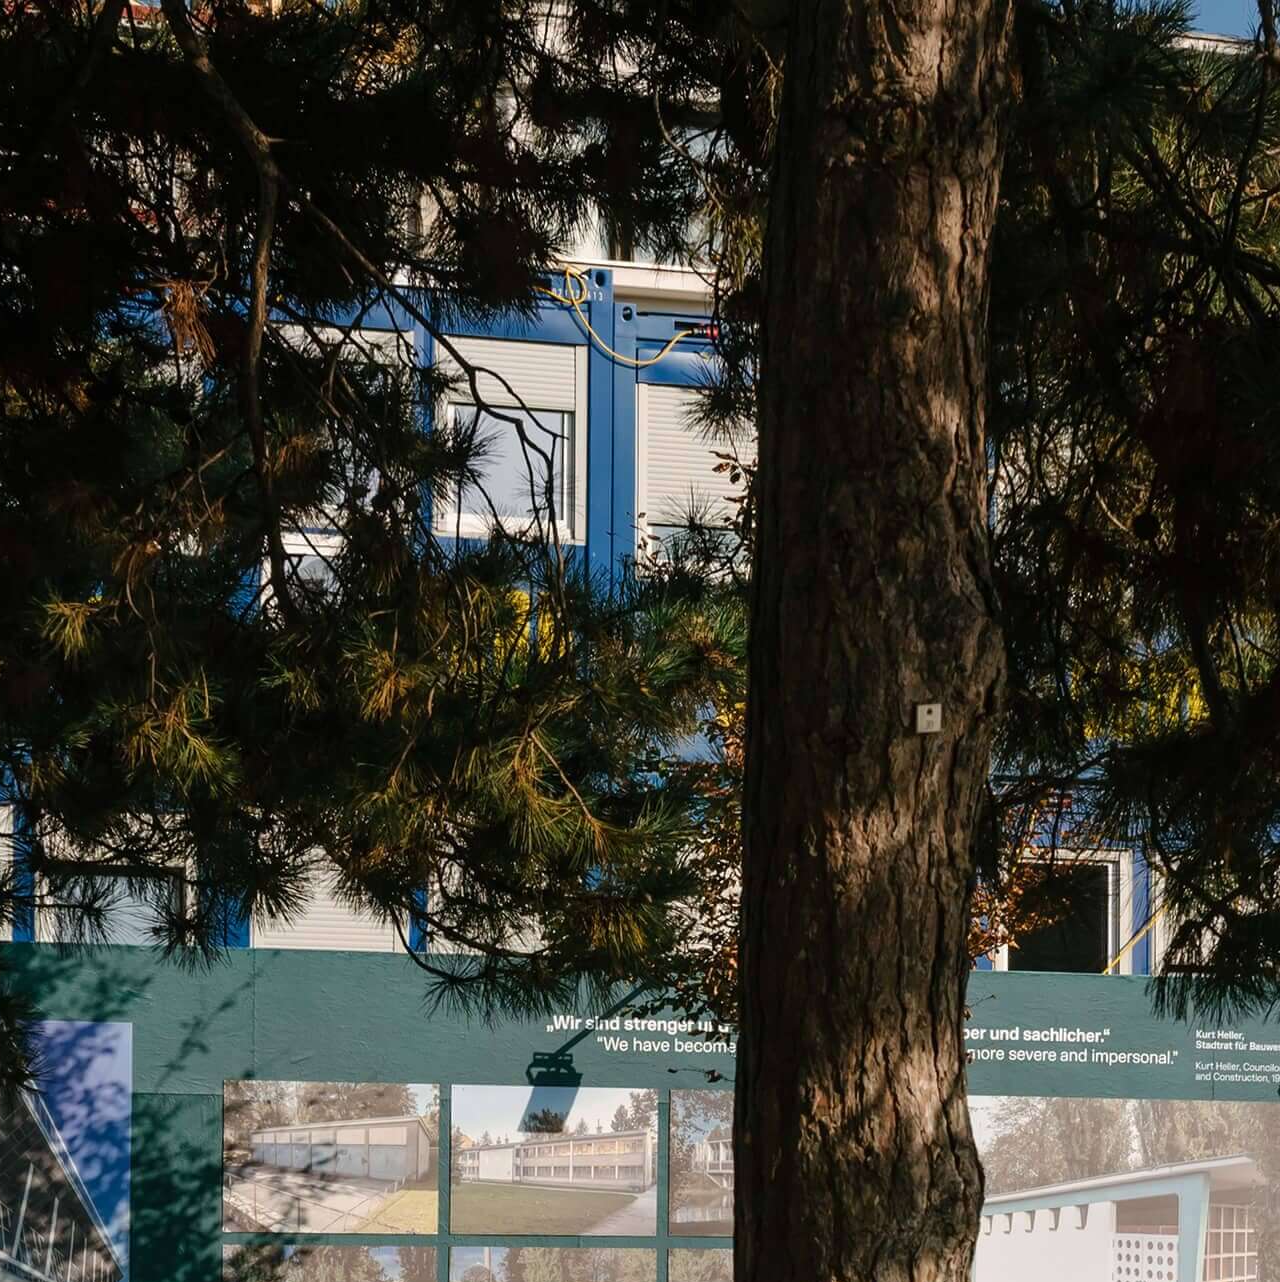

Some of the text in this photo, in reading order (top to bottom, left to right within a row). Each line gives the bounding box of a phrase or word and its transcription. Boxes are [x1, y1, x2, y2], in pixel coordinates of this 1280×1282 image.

[585, 1016, 620, 1031] sind
[624, 1017, 694, 1035] strenger
[990, 1027, 1020, 1041] und
[1195, 1030, 1245, 1041] Kurt Heller,
[632, 1037, 670, 1052] have
[674, 1037, 737, 1053] become
[1195, 1040, 1232, 1050] Stadtrat
[1234, 1041, 1248, 1051] für
[1008, 1049, 1057, 1062] severe
[1060, 1048, 1087, 1063] and
[1195, 1062, 1214, 1071] Kurt
[1195, 1072, 1211, 1081] and
